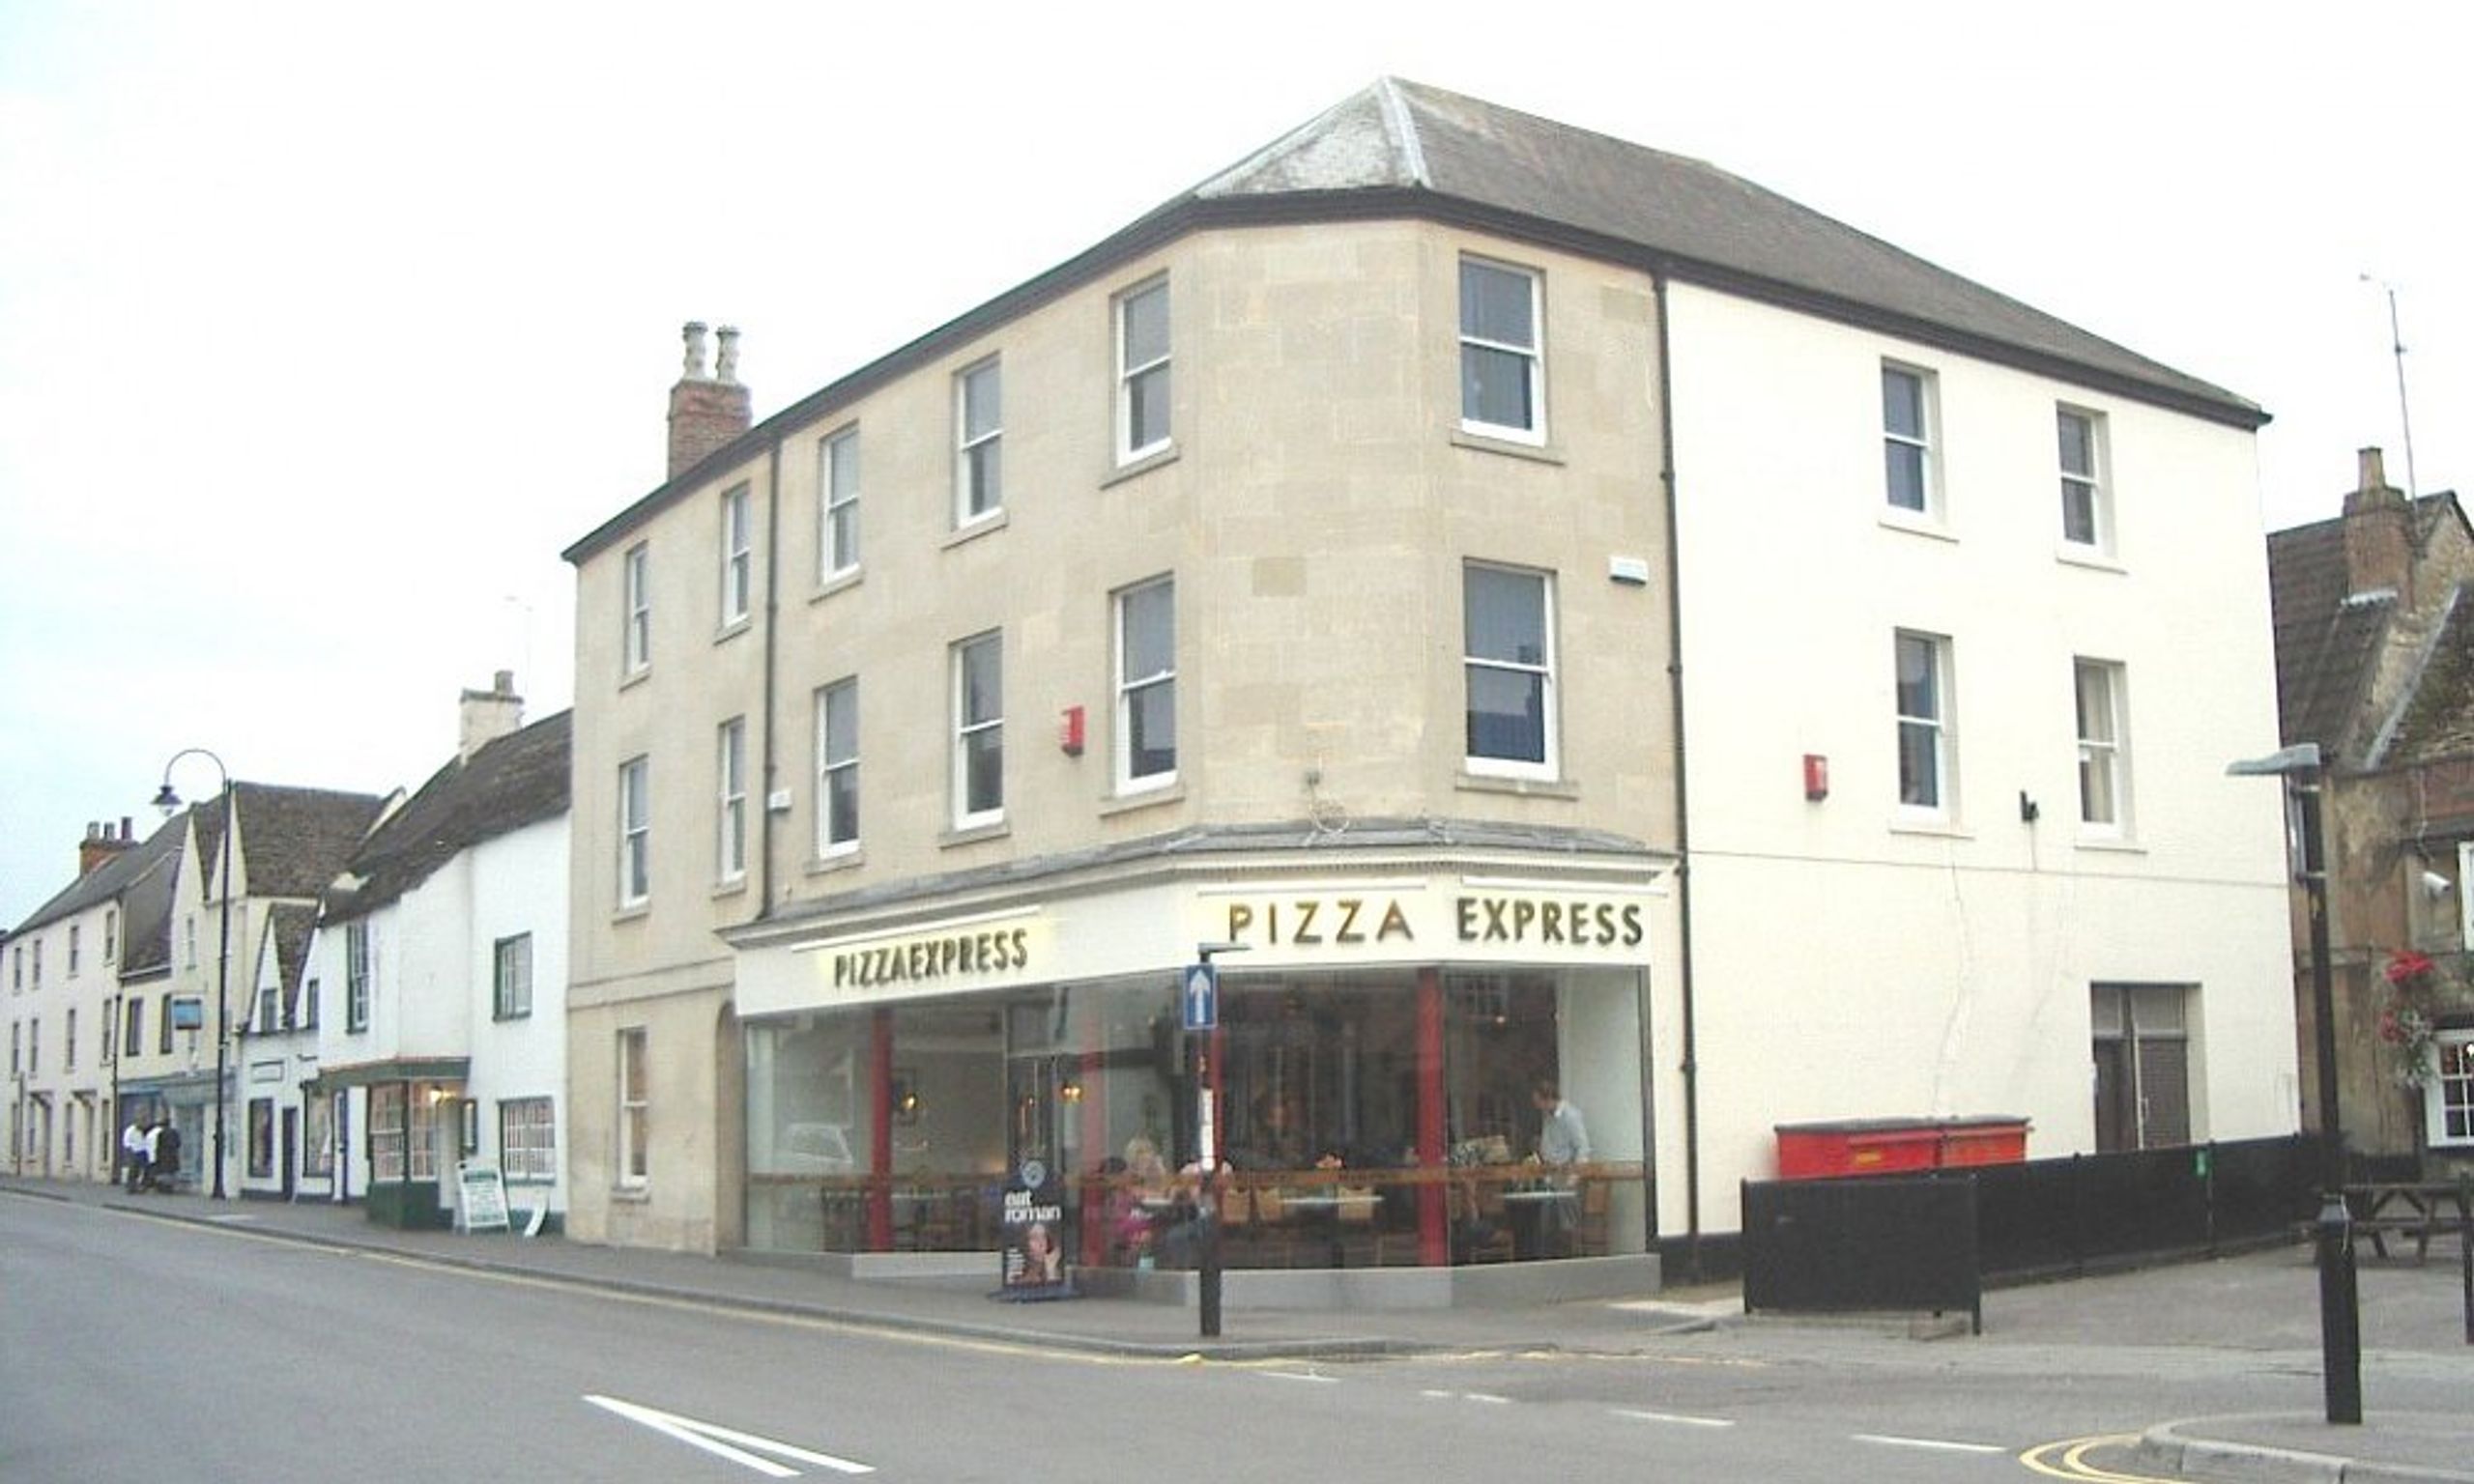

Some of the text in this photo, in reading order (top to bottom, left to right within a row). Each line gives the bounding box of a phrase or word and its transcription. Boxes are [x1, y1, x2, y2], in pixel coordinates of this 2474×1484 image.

[1228, 898, 1644, 947] PIZZA EXPRESS
[834, 928, 1028, 988] PIZZAEXPRESS
[1005, 1206, 1062, 1223] roman
